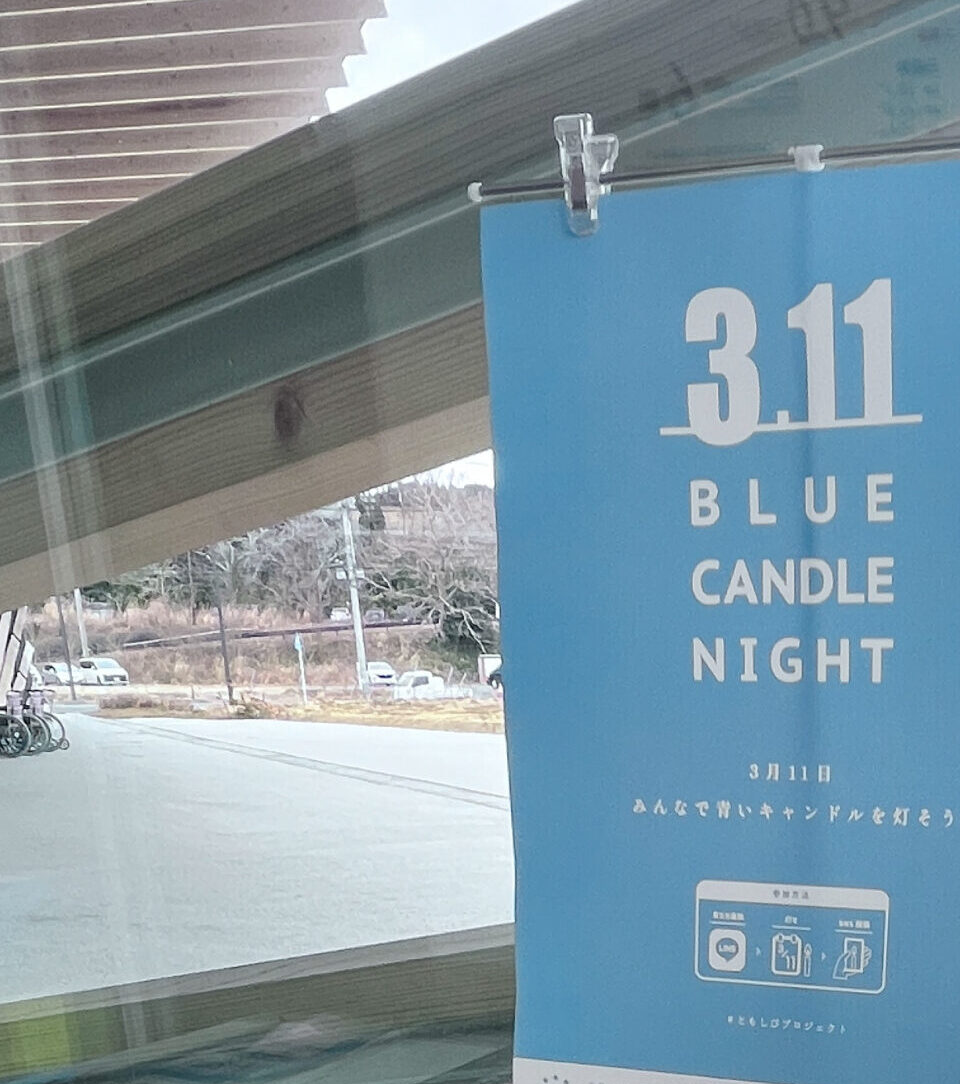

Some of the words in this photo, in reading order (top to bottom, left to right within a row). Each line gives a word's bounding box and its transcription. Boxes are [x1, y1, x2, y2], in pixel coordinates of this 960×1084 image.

[685, 278, 893, 446] 3.11
[690, 473, 894, 526] BLUE
[692, 557, 894, 605] CANDLE
[693, 638, 894, 683] NIGHT
[749, 763, 832, 783] 3月11日
